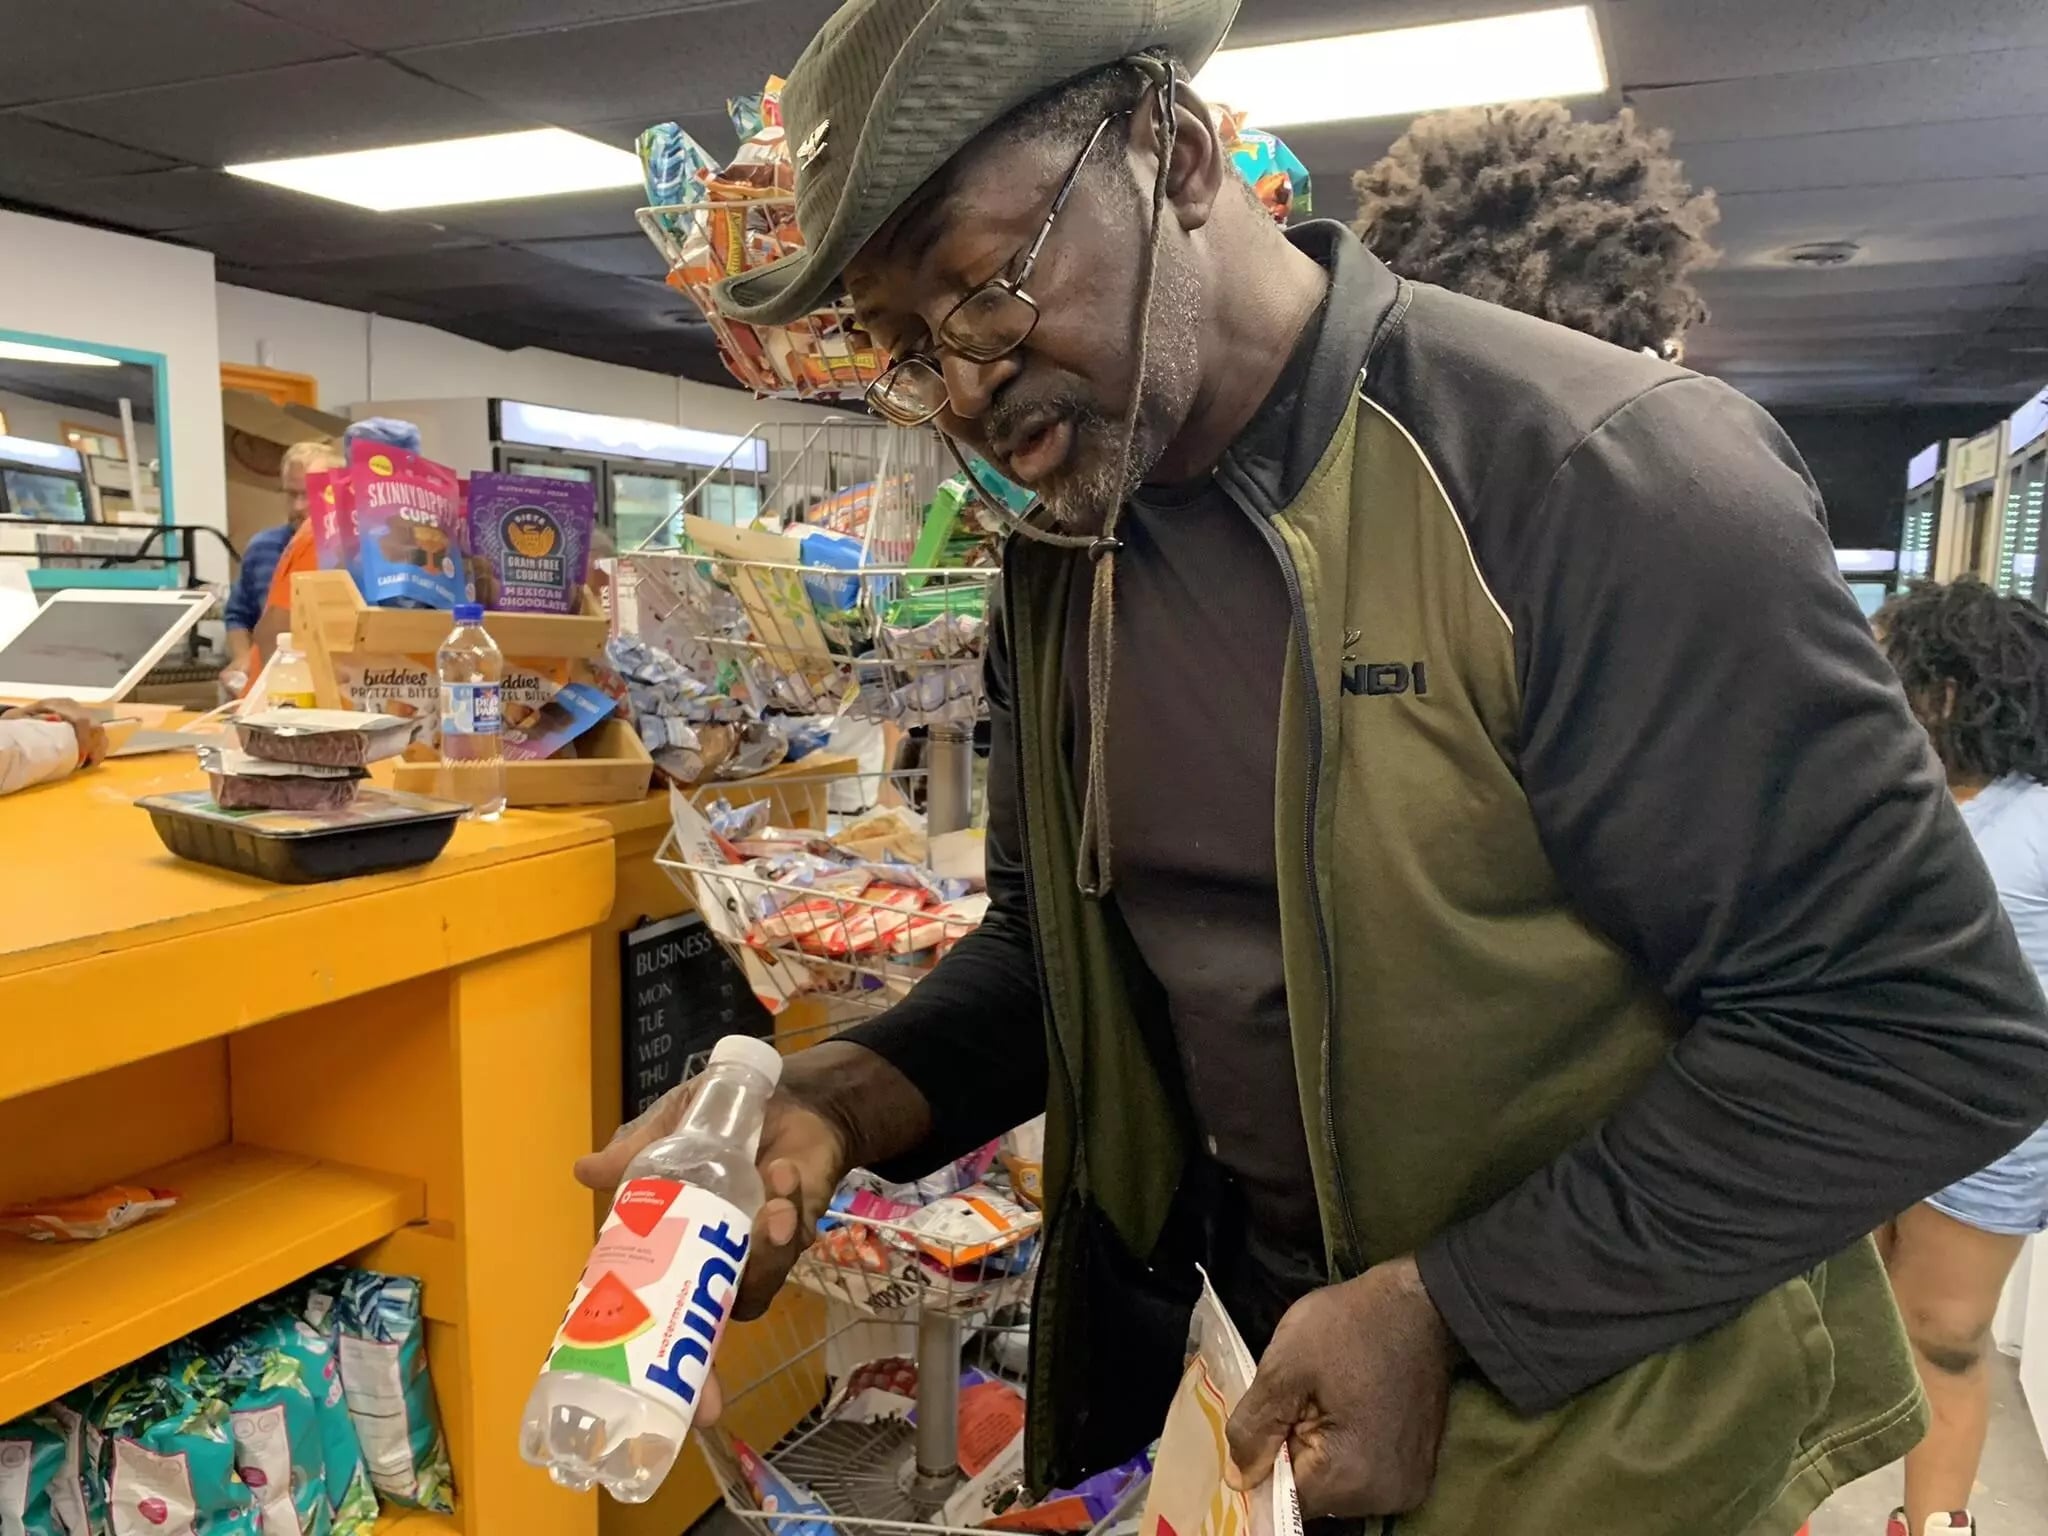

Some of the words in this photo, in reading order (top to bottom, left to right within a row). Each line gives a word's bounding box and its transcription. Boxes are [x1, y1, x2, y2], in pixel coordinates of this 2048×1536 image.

[400, 506, 439, 527] CUPS
[508, 556, 535, 569] GRAIN
[538, 559, 560, 571] FREE
[515, 569, 554, 582] COOKIES
[499, 596, 568, 611] CHOCOLATE
[505, 587, 562, 599] MEXICAN
[363, 668, 429, 686] buddies
[351, 687, 401, 699] PRETZEL
[407, 687, 440, 699] BITES
[636, 930, 712, 977] BUSINESS
[638, 980, 673, 1008] MON
[638, 1009, 665, 1035] TUE
[638, 1034, 672, 1062] WED
[639, 1061, 669, 1089] THU
[646, 1220, 750, 1405] hint
[657, 1279, 692, 1359] watermelon
